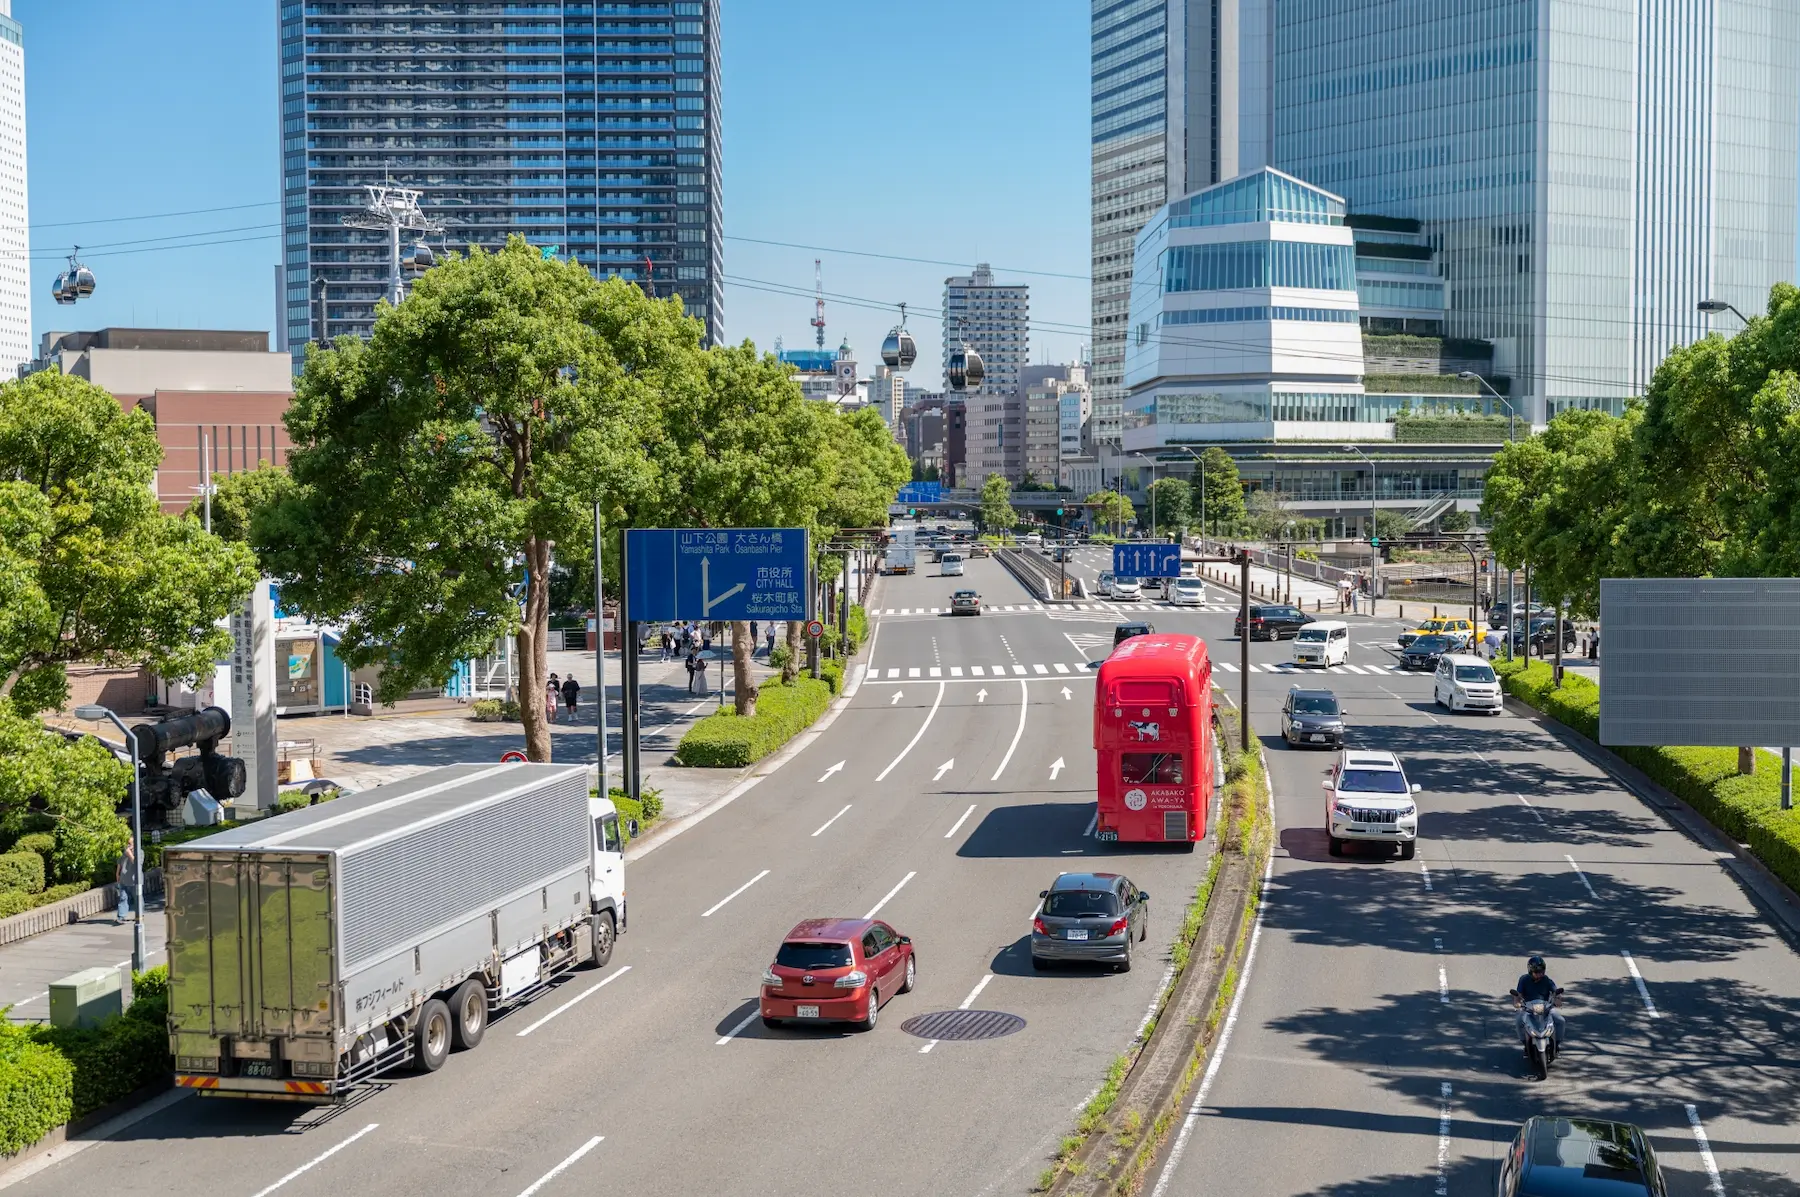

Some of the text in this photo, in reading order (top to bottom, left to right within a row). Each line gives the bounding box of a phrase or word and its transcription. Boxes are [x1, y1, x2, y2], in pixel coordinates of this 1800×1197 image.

[681, 532, 782, 544] 山下公園 大さん橋
[680, 544, 783, 554] Yamashita Park Osanbashi Pier
[757, 567, 793, 578] 市役所
[756, 579, 794, 589] CITY HALL
[751, 592, 799, 603] 桜木町駅
[746, 604, 804, 616] Sakuragicho Sta.
[811, 625, 820, 633] 50
